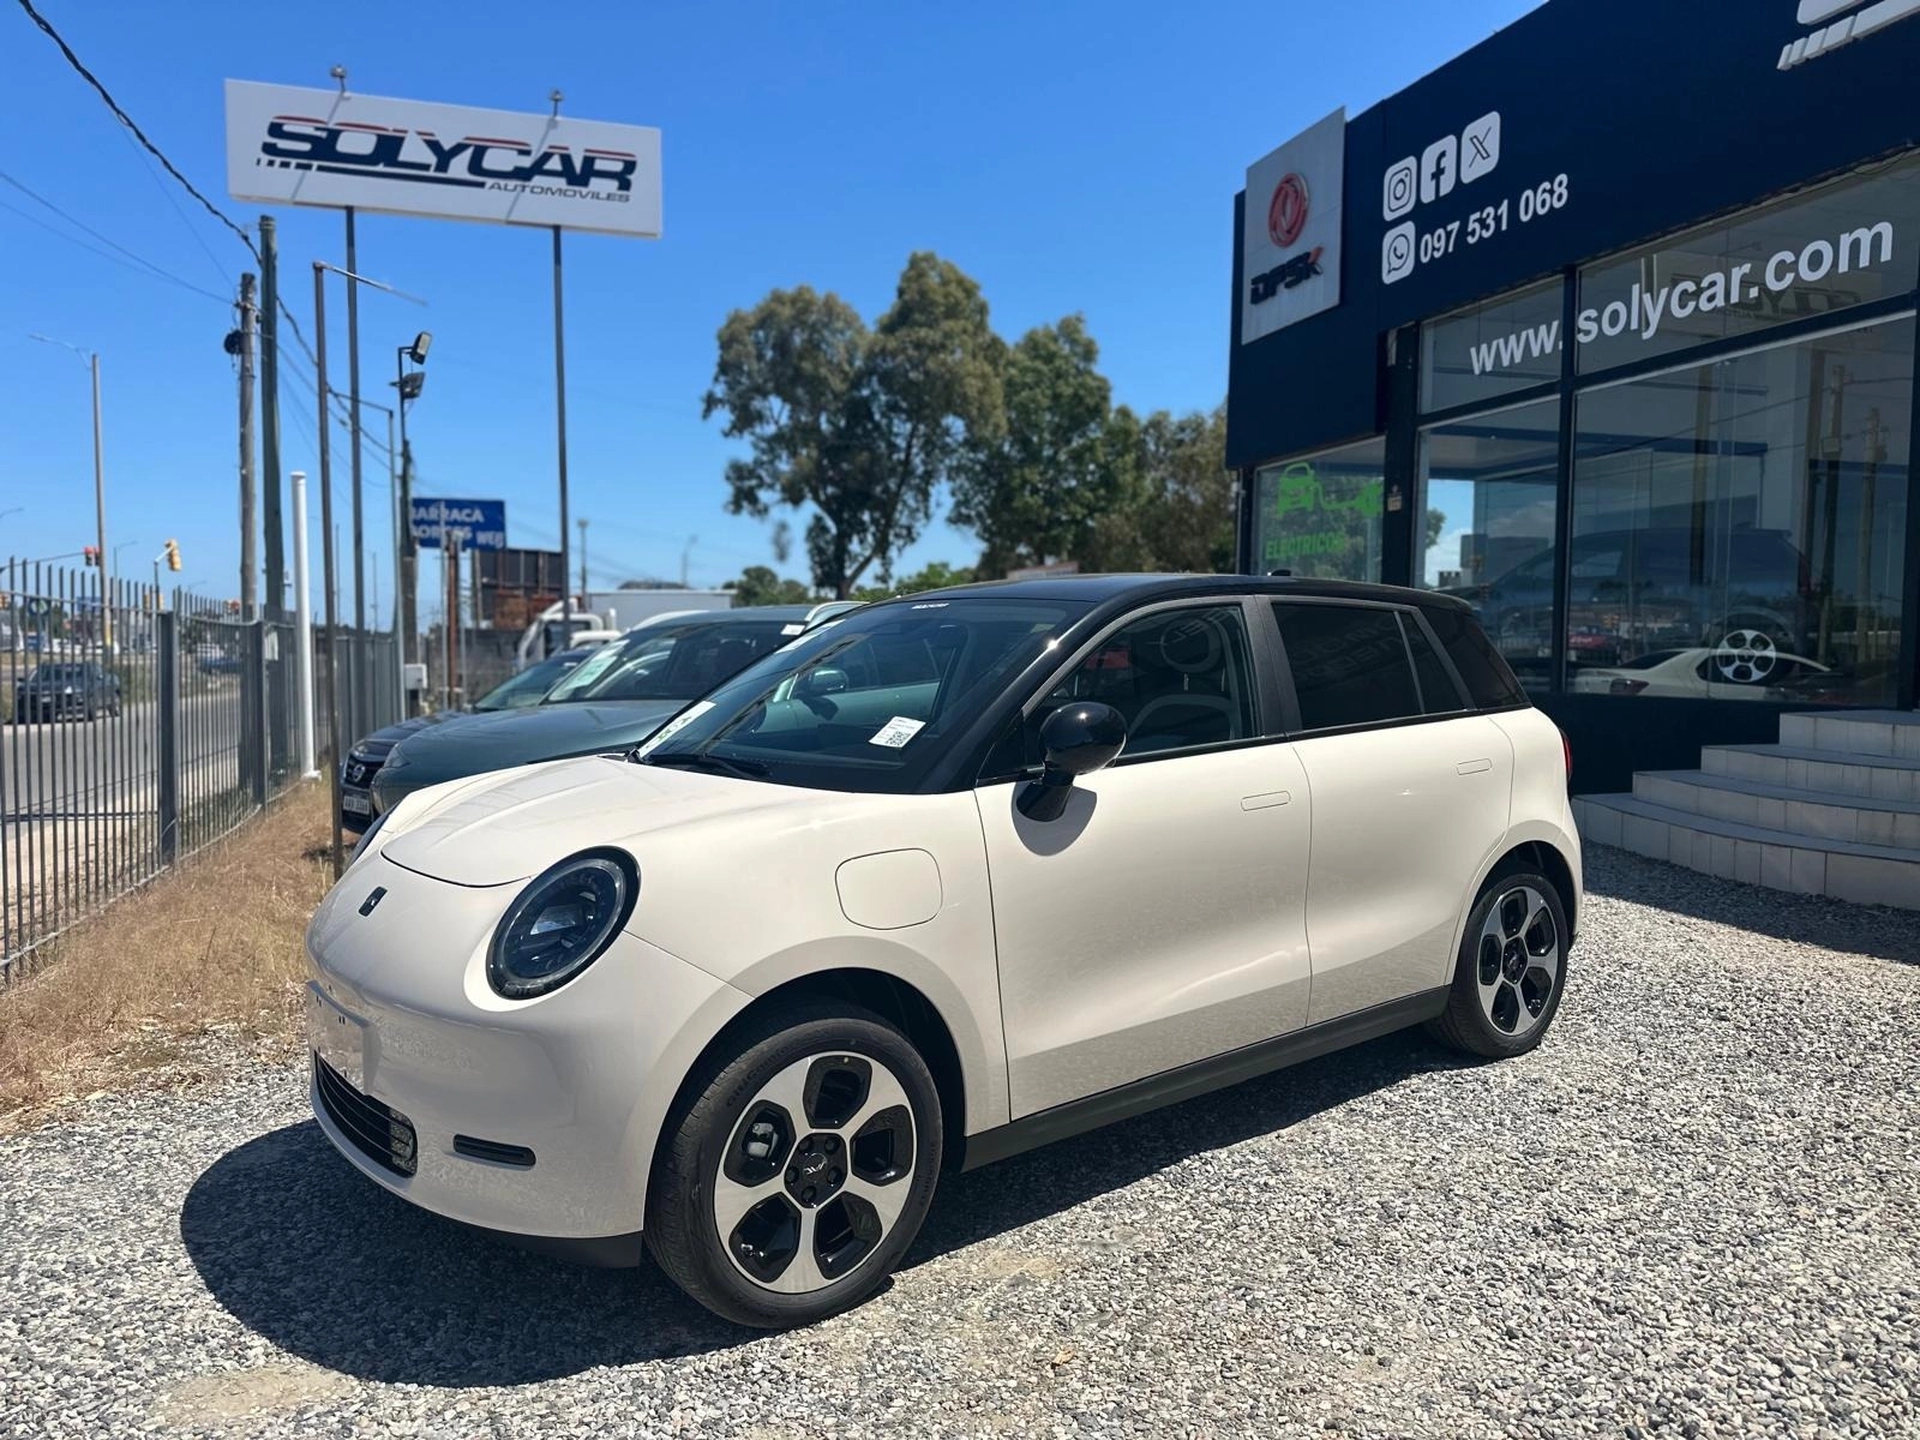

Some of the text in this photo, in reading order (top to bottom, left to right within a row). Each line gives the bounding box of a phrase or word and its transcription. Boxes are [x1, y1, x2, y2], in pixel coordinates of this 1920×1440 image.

[260, 115, 639, 193] SOLYCAR
[487, 180, 631, 204] AUTOMOVILES
[1419, 173, 1569, 264] 097 531 068
[1469, 220, 1895, 375] www.solycar.com
